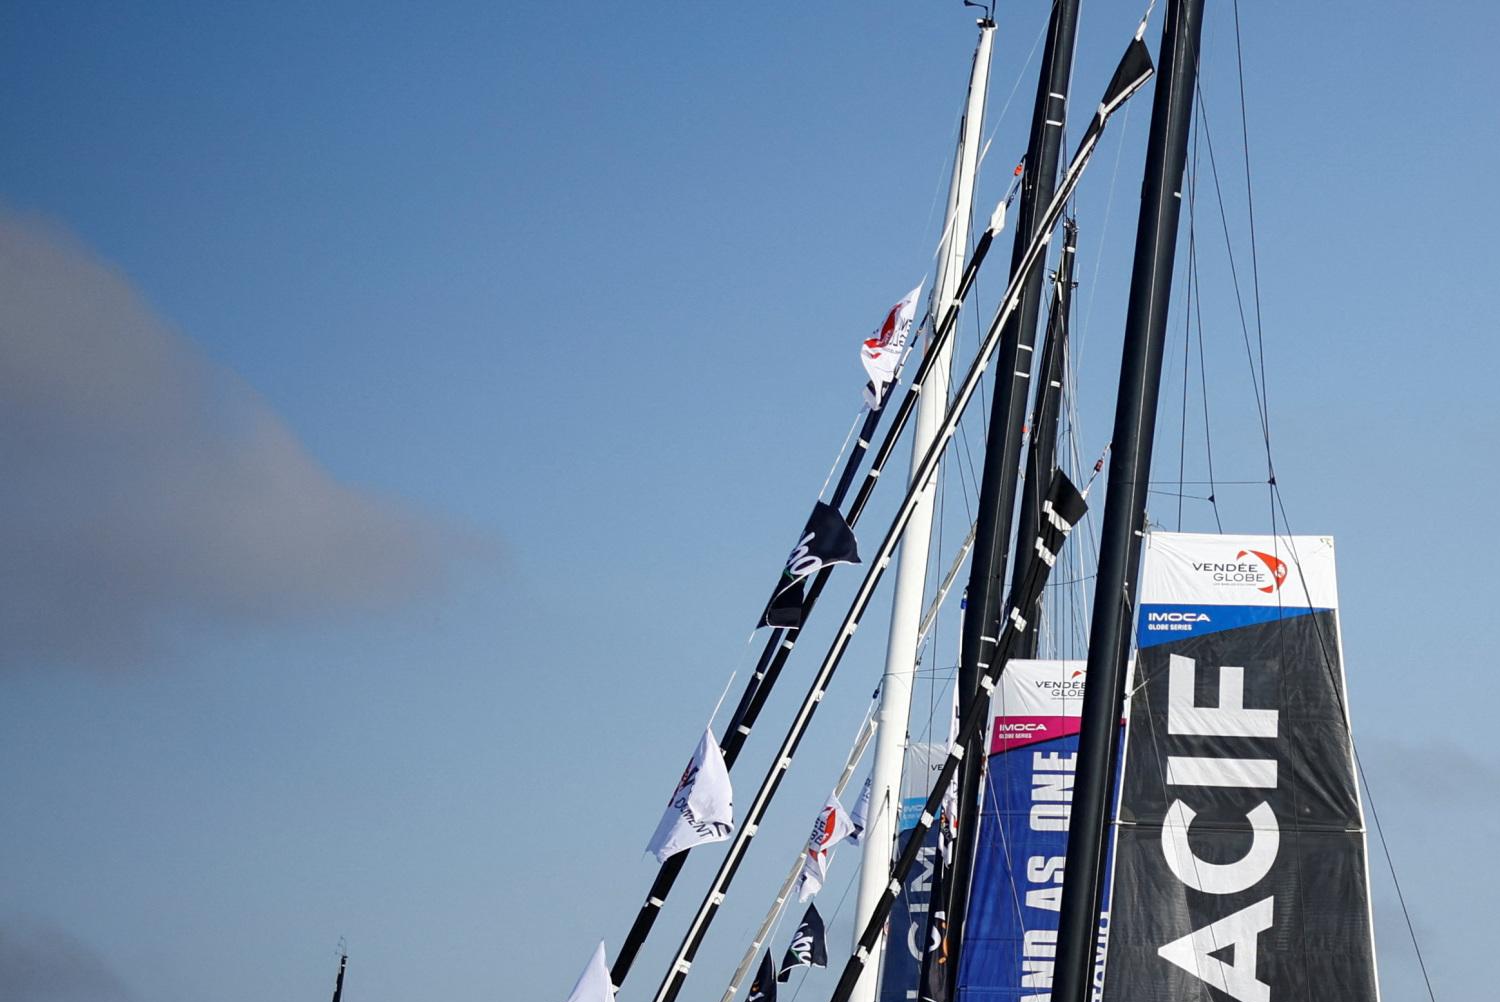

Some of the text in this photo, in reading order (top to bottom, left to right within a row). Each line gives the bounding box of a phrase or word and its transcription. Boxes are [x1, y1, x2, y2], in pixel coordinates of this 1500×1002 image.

[1192, 562, 1258, 573] VENDÉE
[1213, 572, 1265, 583] GLOBE
[1148, 612, 1211, 622] IMOCA
[999, 723, 1047, 732] IMOCA
[1029, 751, 1078, 832] ONE
